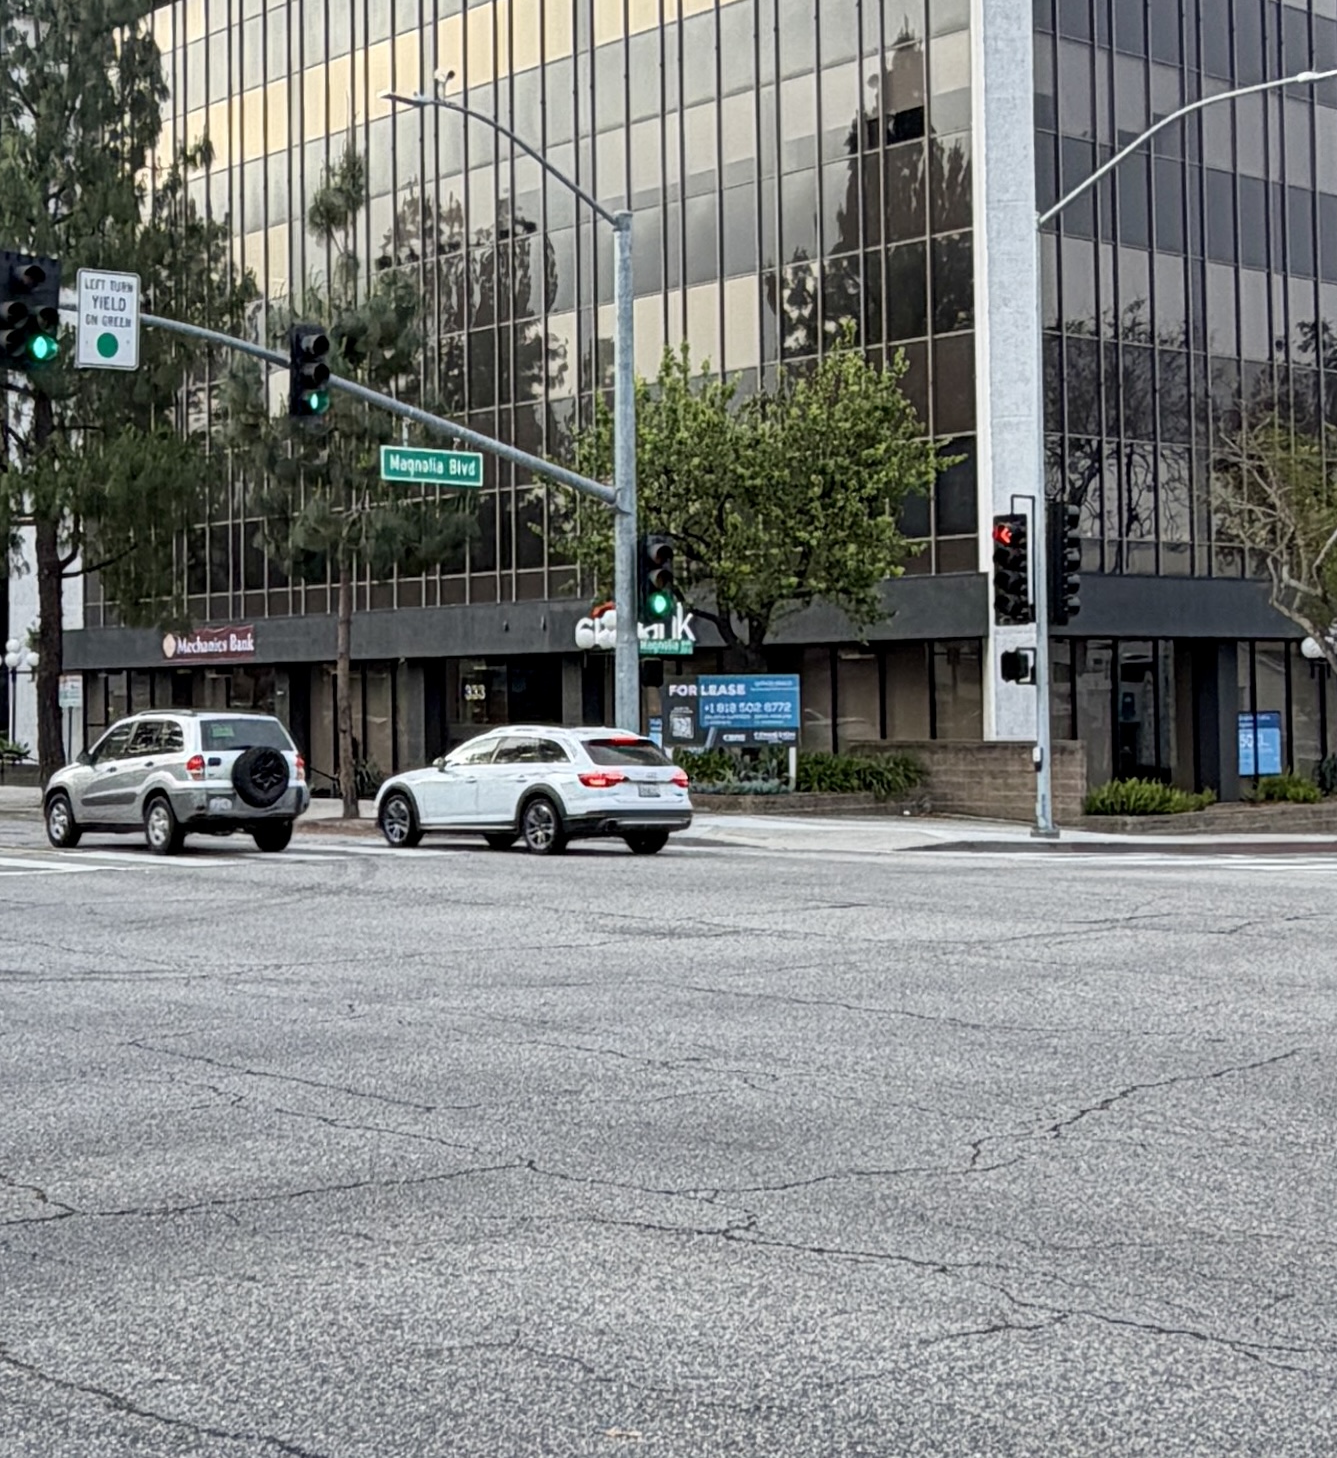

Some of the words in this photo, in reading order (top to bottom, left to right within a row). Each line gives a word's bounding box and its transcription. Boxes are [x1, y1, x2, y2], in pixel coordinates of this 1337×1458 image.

[84, 278, 105, 290] LEFT
[110, 280, 133, 293] TURN
[92, 295, 126, 312] YIELD
[85, 313, 98, 325] ON
[102, 315, 131, 328] GREEN
[389, 453, 444, 477] Magnolia
[449, 458, 476, 476] Blvd
[177, 636, 227, 654] Mechanics
[229, 633, 254, 652] Bank
[669, 684, 697, 696] FOR
[700, 683, 746, 696] LEASE
